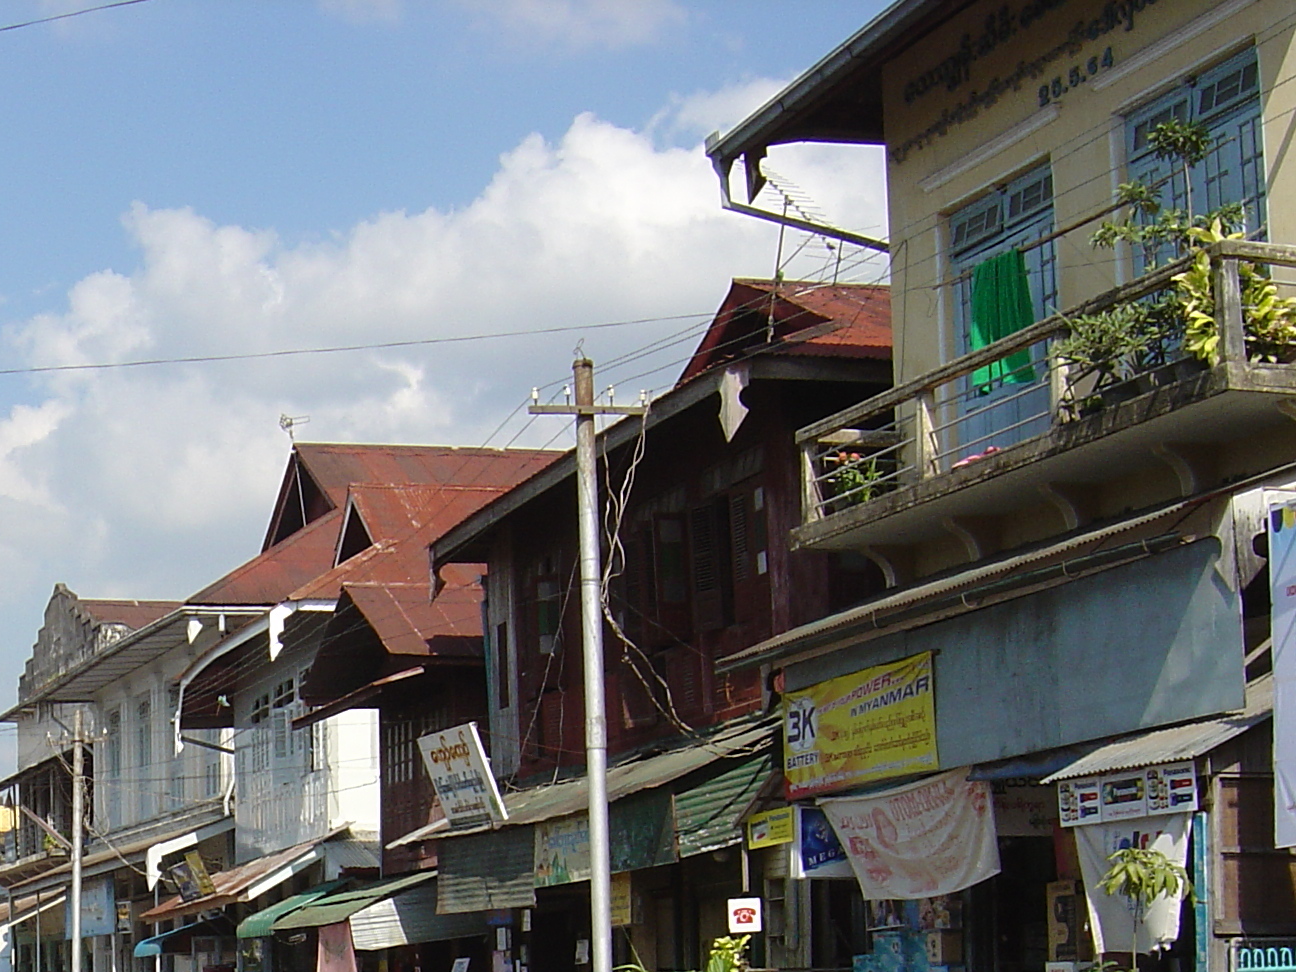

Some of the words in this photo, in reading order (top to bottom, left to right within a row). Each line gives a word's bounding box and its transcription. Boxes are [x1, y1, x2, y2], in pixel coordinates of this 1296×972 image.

[858, 675, 930, 715] MYANMAR
[787, 706, 816, 743] 3K
[787, 752, 819, 769] BATTERY
